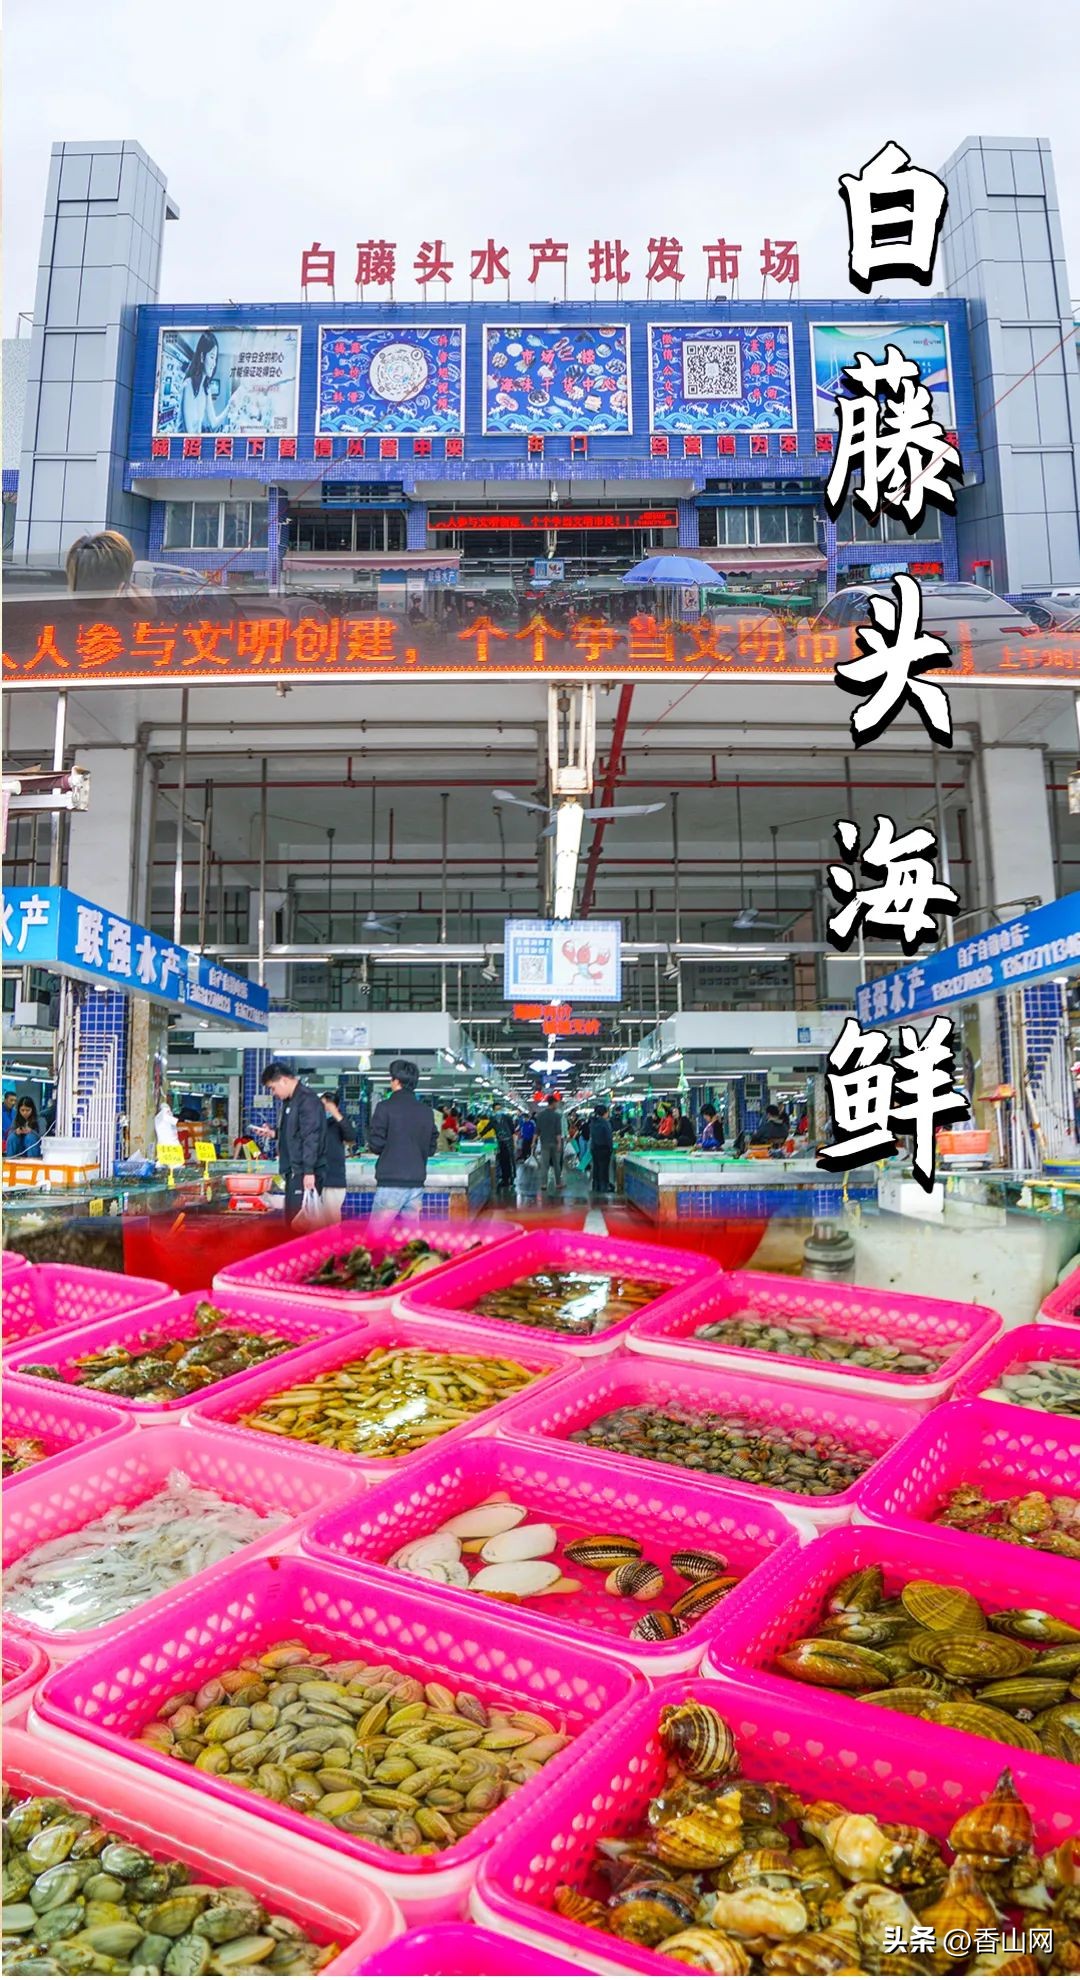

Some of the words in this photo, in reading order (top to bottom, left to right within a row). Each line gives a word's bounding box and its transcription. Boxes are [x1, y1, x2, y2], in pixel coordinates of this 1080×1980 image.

[300, 236, 800, 286] 白藤头水产批发市场
[521, 349, 596, 365] 市场二楼
[500, 376, 617, 393] 海味干货中心
[75, 904, 184, 991] 联强水产
[857, 967, 925, 1023] 联强水产
